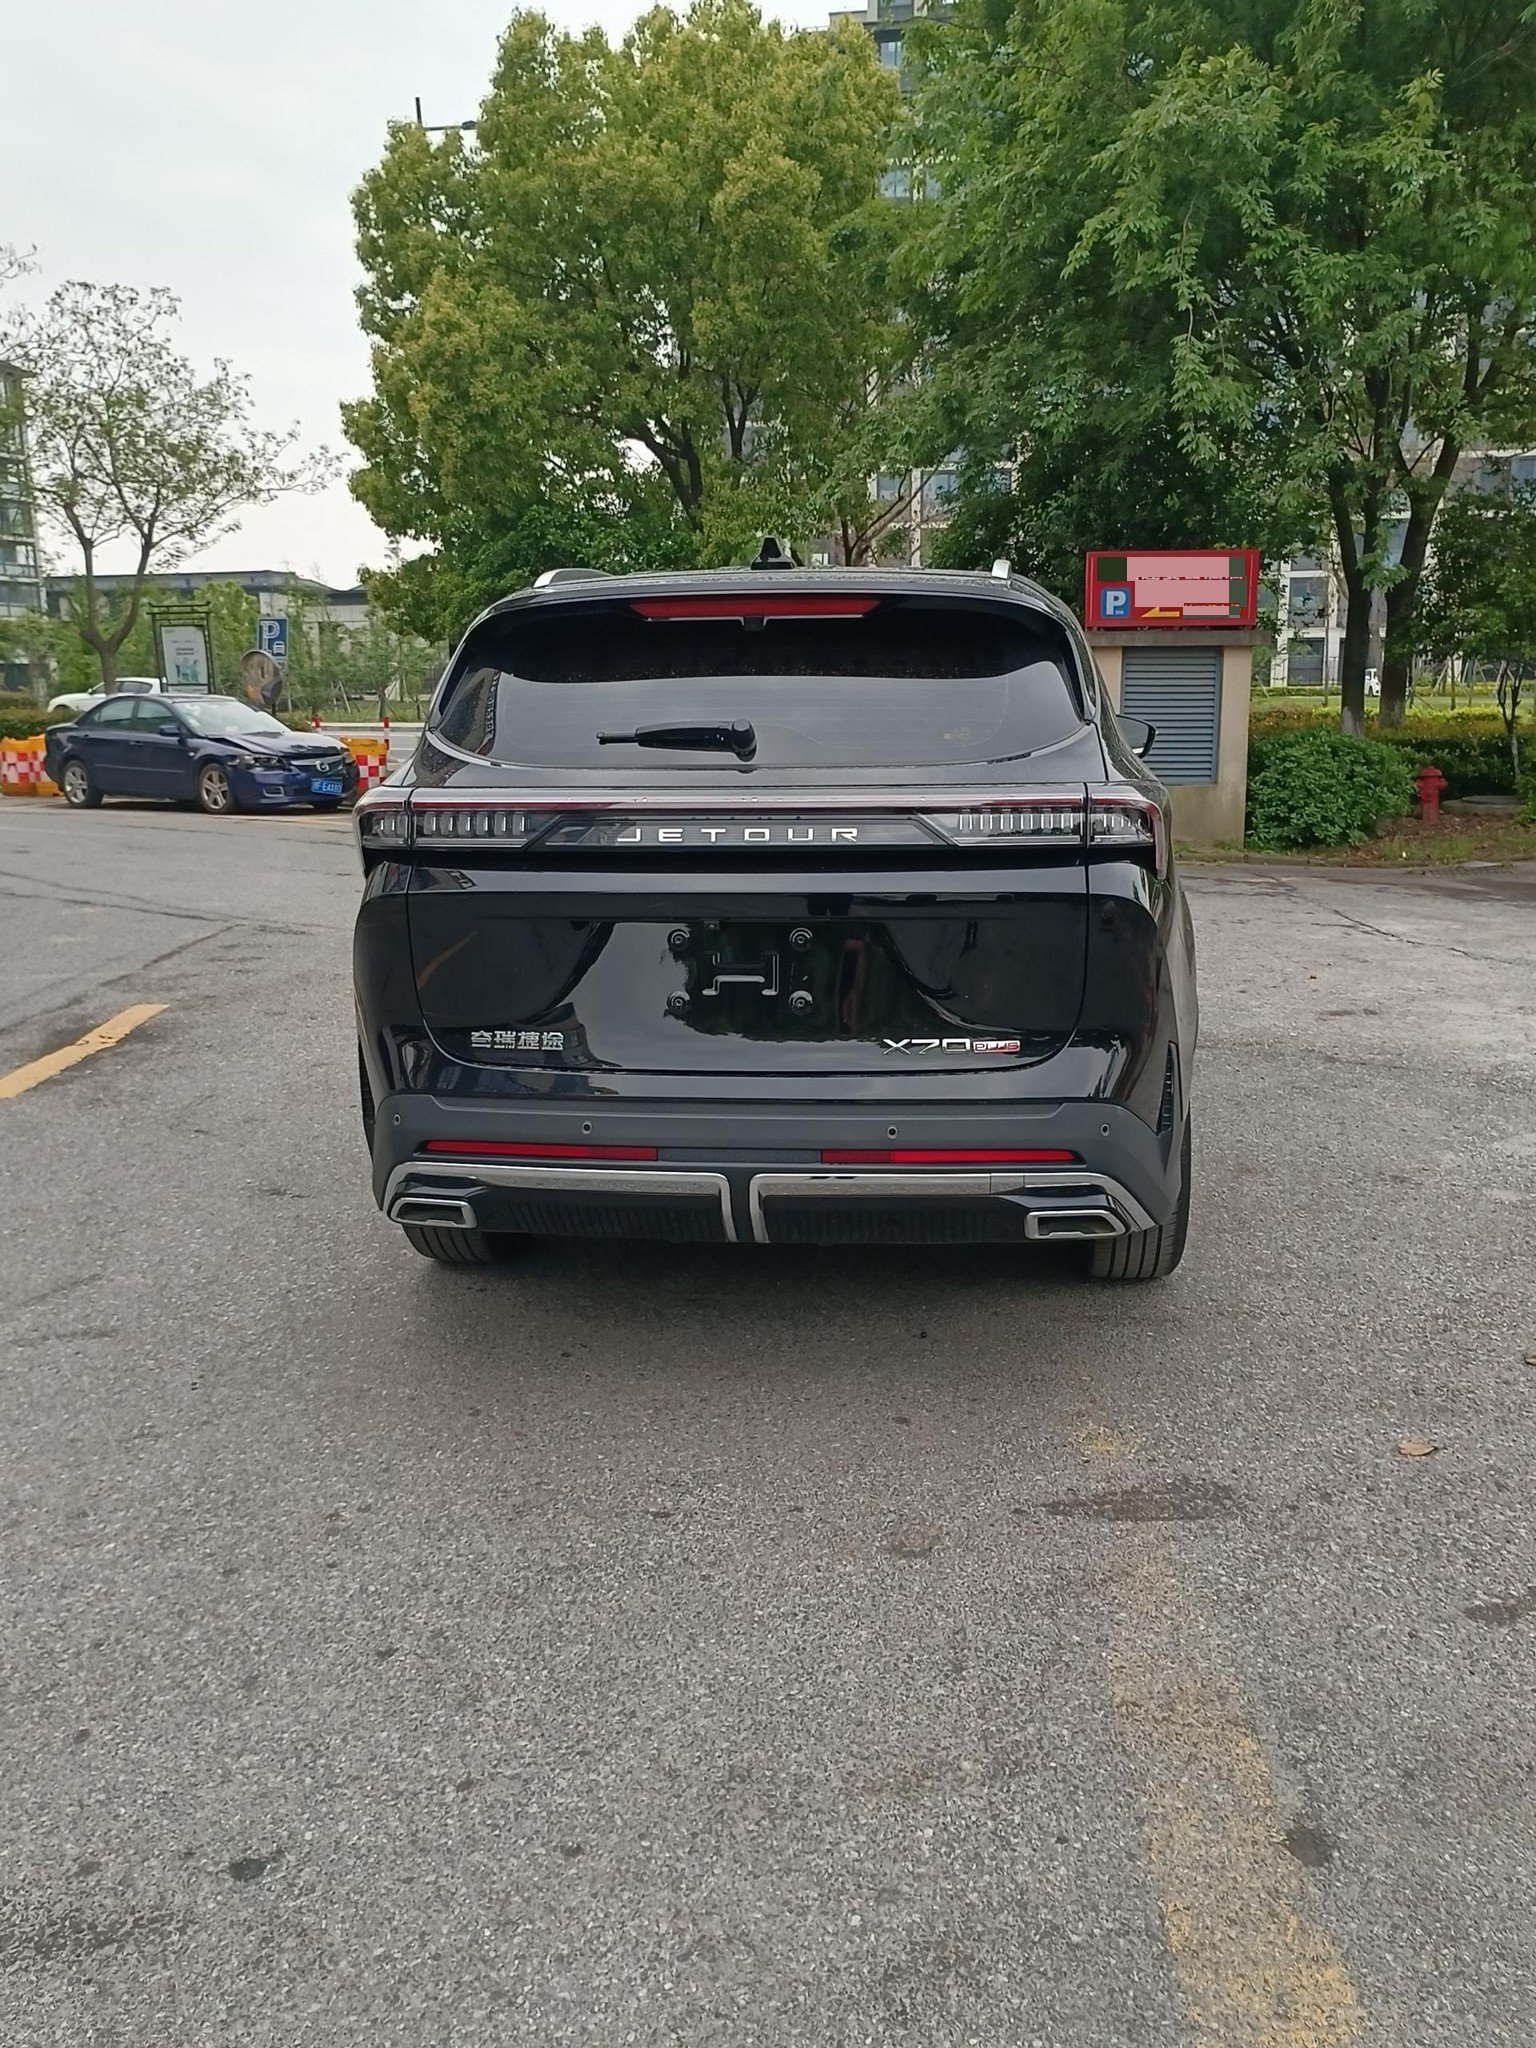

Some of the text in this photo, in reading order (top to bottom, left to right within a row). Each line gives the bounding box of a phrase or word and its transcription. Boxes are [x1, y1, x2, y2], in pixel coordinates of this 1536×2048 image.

[1106, 591, 1126, 615] P
[260, 621, 280, 650] P
[616, 827, 858, 844] JETOUR
[470, 1029, 564, 1051] 奇瑞捷途
[882, 1038, 1020, 1055] X70 PLUS
